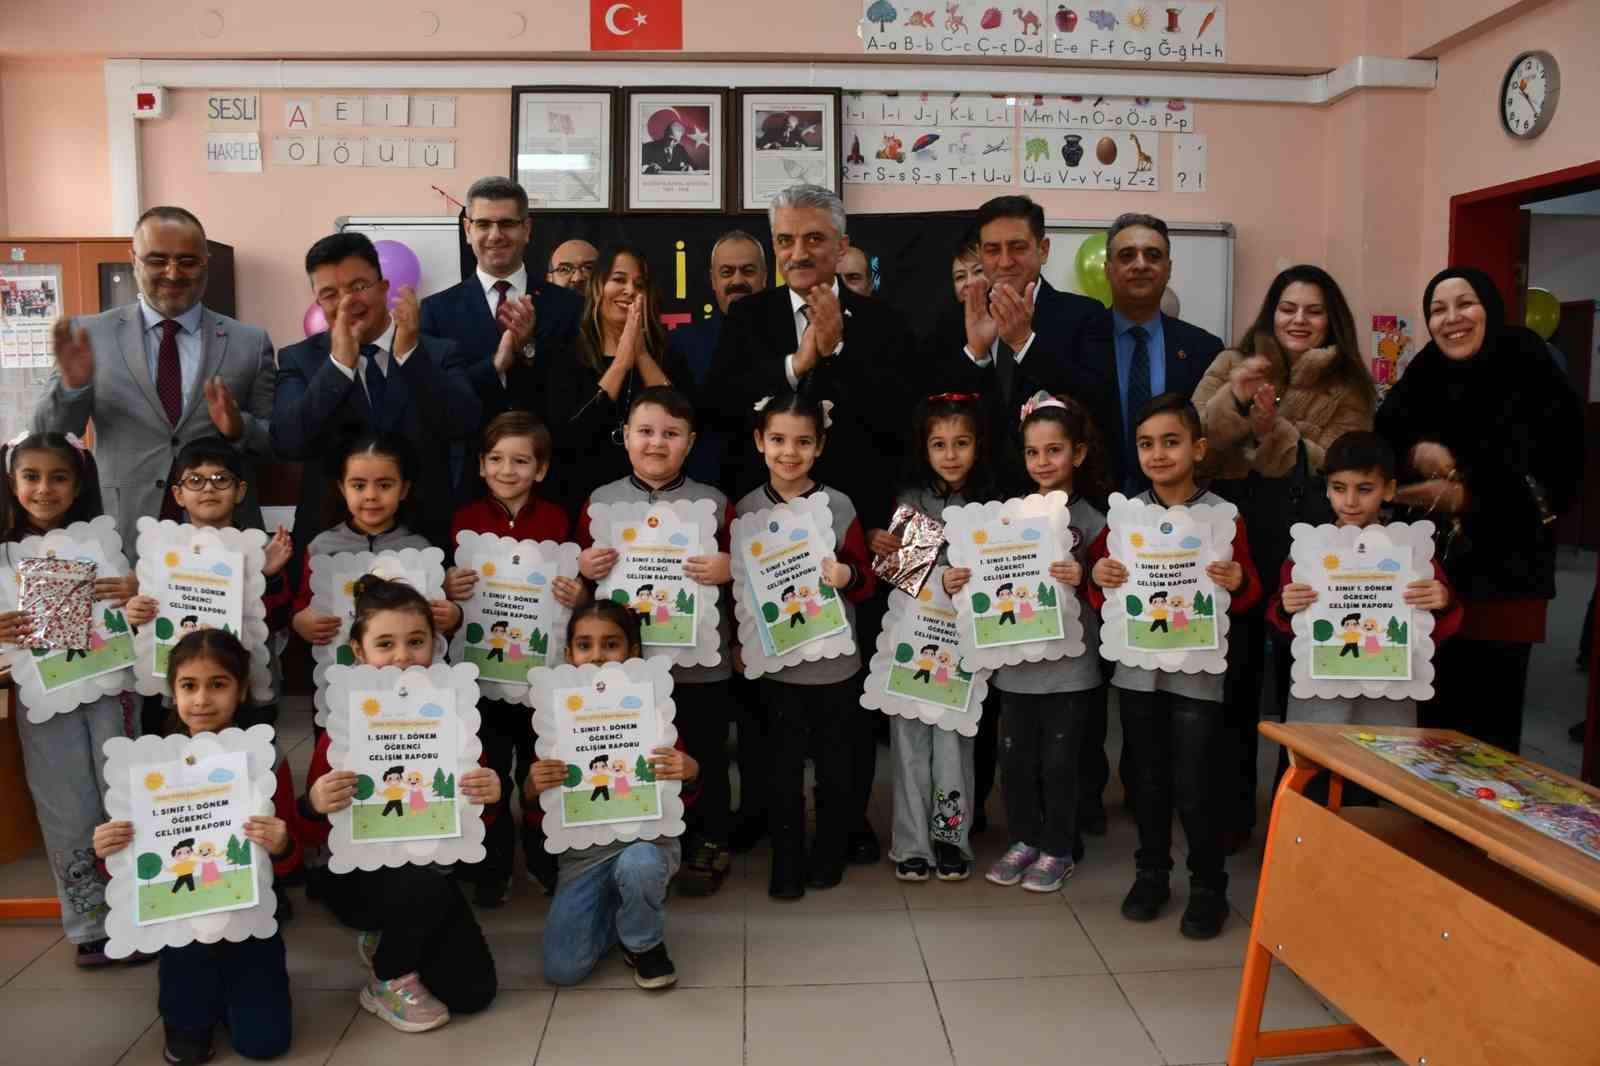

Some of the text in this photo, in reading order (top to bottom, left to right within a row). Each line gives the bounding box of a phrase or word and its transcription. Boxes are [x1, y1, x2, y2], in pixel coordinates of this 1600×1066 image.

[867, 36, 897, 50] A-a
[904, 36, 934, 51] B-b
[1014, 38, 1043, 53] D-d
[1054, 39, 1078, 54] E-e
[1123, 41, 1152, 61] G-g
[1191, 43, 1223, 57] H-h
[288, 104, 308, 128] A
[336, 102, 348, 121] E
[1058, 110, 1088, 124] N-n
[1093, 110, 1122, 125] O-o
[333, 141, 350, 164] Ö
[947, 167, 976, 182] T-t
[1058, 169, 1087, 184] V-v
[1092, 170, 1121, 191] Y-y
[1127, 171, 1155, 186] Z-z
[941, 637, 959, 646] RAPO
[160, 806, 185, 816] SINIF
